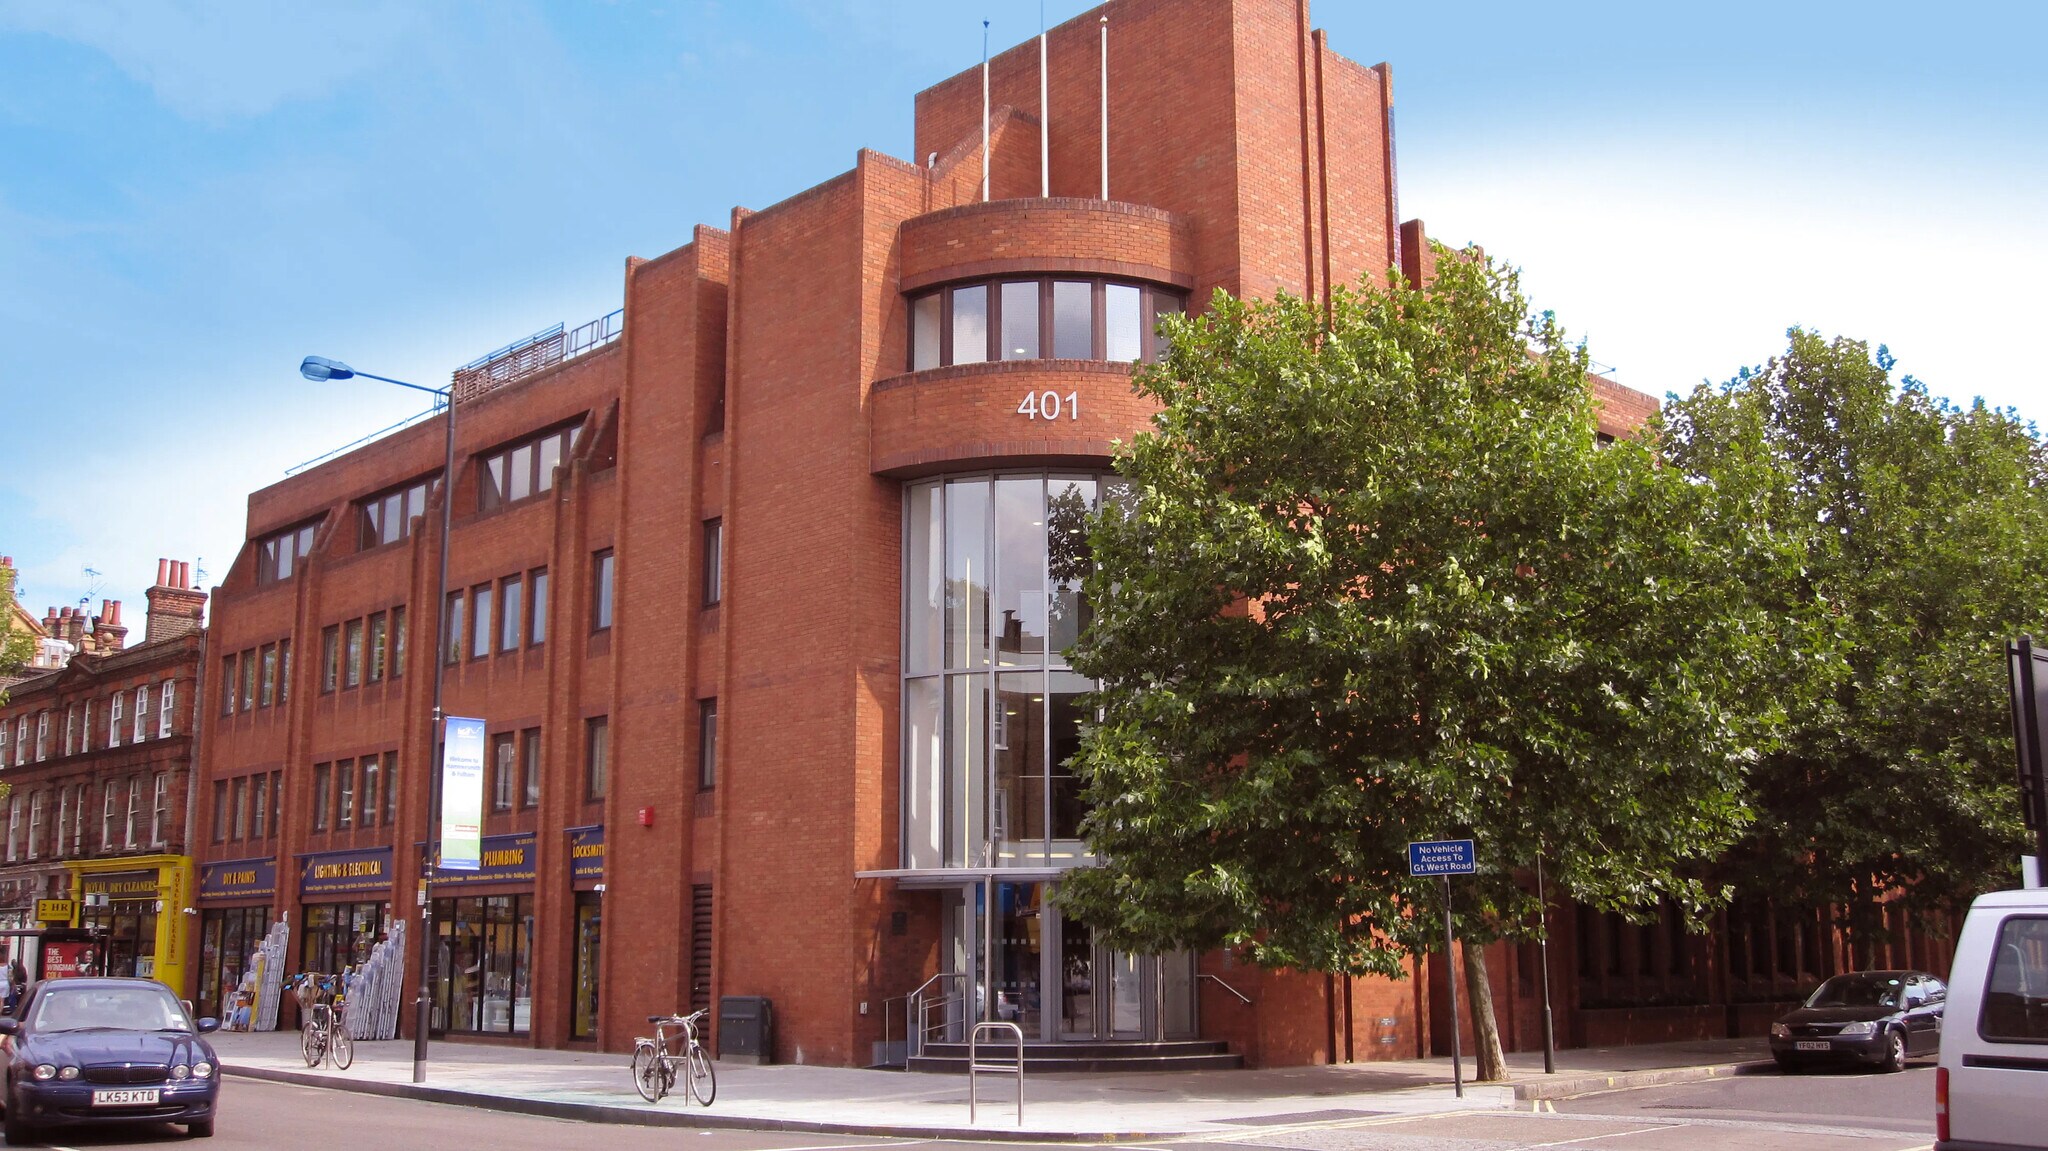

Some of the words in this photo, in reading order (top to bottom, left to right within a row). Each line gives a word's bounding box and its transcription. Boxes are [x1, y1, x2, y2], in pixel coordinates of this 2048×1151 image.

[1017, 390, 1078, 420] 401
[1419, 846, 1431, 854] No
[1432, 844, 1463, 854] Vehicle
[483, 848, 524, 866] PLUMBING
[1420, 854, 1452, 863] Access
[1453, 853, 1463, 861] To
[314, 863, 341, 879] LIGHTING
[342, 862, 348, 877] &
[349, 860, 382, 876] ELECTRICAL
[1450, 862, 1472, 870] Road
[223, 872, 233, 885] DIY
[233, 872, 237, 885] &
[238, 870, 256, 884] PAINTS
[85, 881, 107, 892] ROYAL
[110, 881, 122, 893] DRY
[124, 880, 159, 892] CLEANERS
[41, 903, 47, 911] 2
[51, 903, 69, 911] HR
[47, 947, 60, 955] THE
[47, 955, 63, 964] BEST
[47, 963, 76, 971] WINGMAN
[98, 1091, 129, 1103] LK53
